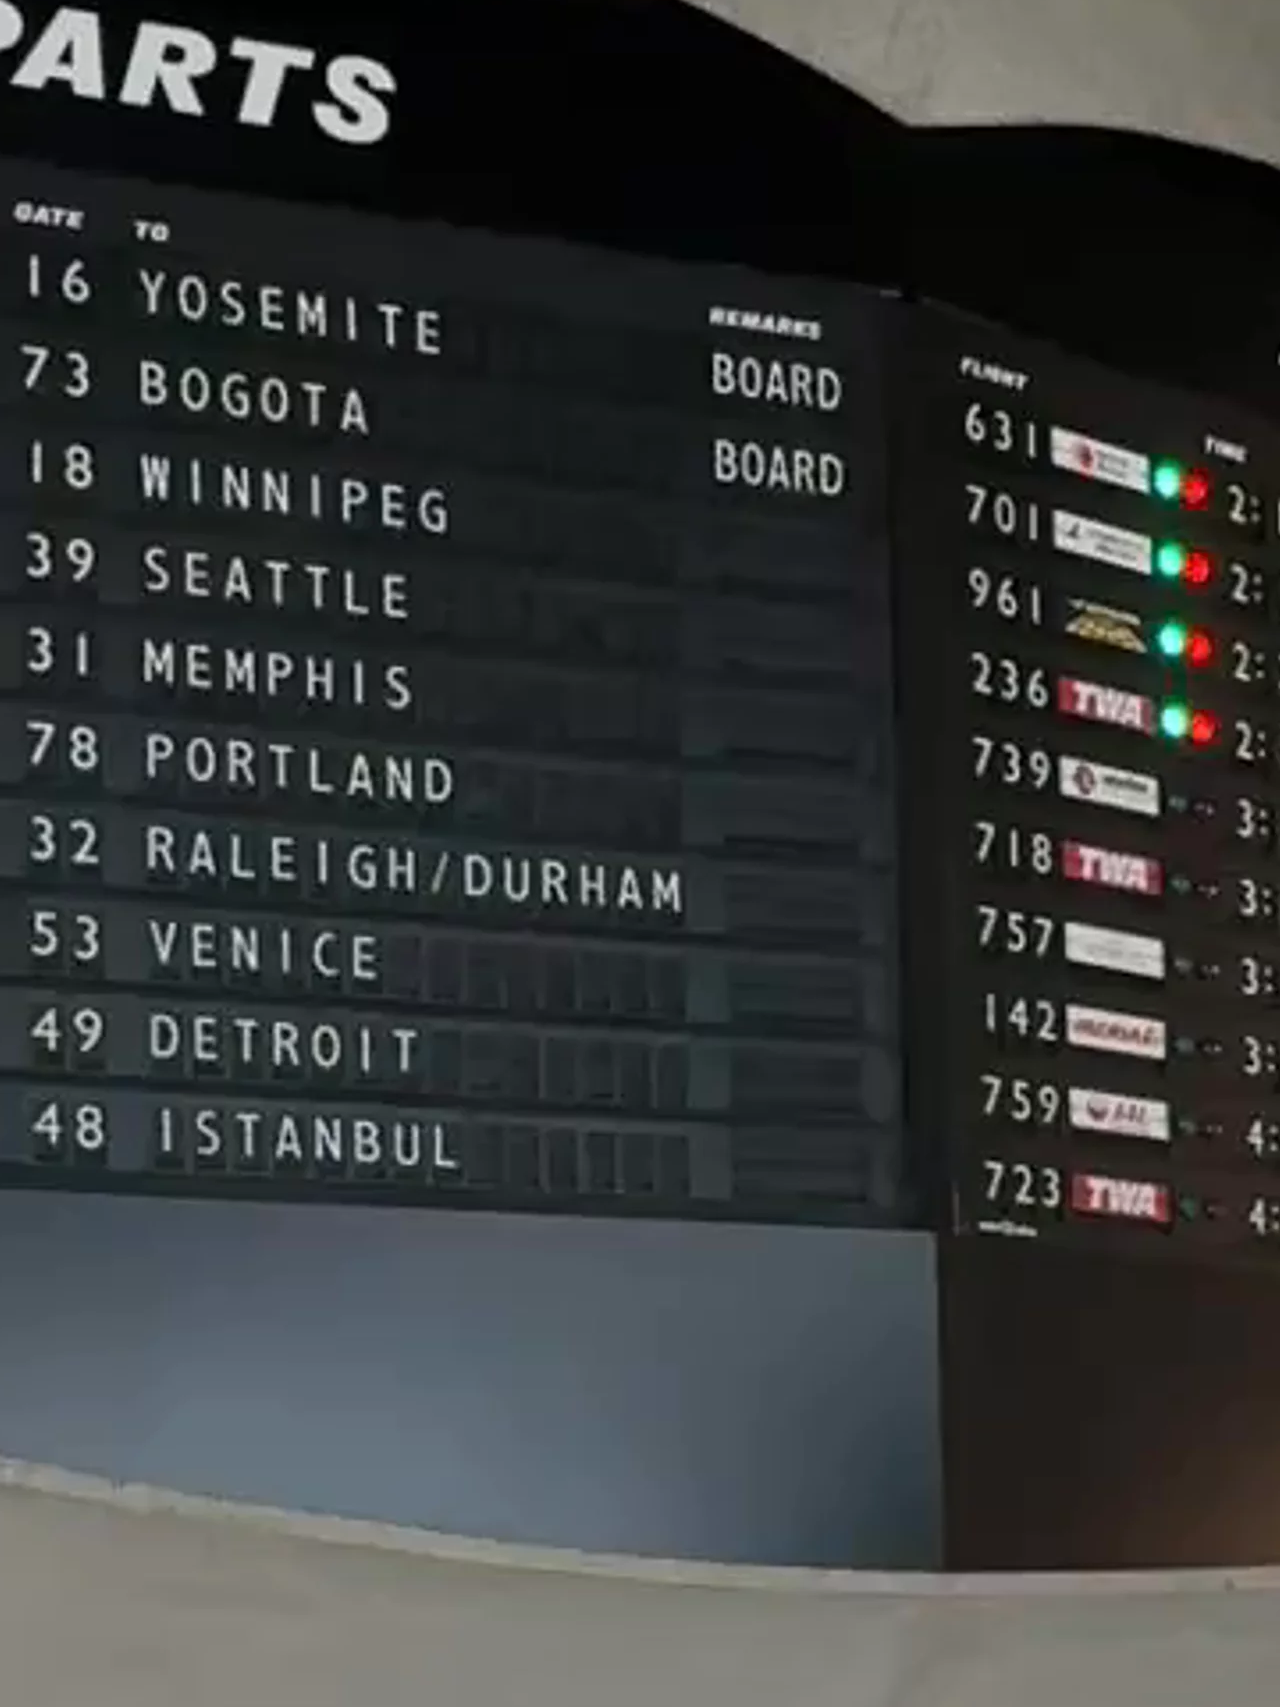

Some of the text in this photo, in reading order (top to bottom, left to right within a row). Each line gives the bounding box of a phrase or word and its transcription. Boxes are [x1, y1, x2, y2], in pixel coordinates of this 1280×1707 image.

[13, 202, 84, 229] GATE
[134, 220, 170, 242] TO
[29, 254, 90, 303] 16
[139, 269, 440, 355] YOSEMITE
[712, 352, 842, 410] BOARD
[21, 345, 90, 398] 73
[140, 360, 368, 434] BOGOTA
[714, 438, 843, 496] BOARD
[965, 403, 1036, 458] 631
[32, 441, 93, 490] 18
[140, 454, 447, 533] WINNIPEG
[965, 484, 1038, 541] 701
[26, 532, 94, 582] 39
[144, 546, 408, 618] SEATTLE
[968, 568, 1040, 624] 961
[28, 627, 88, 675] 31
[143, 639, 411, 710] MEMPHIS
[971, 651, 1048, 708] 236
[1073, 680, 1144, 727] TWA
[27, 721, 98, 771] 78
[146, 733, 452, 802] PORTLAND
[972, 736, 1051, 789] 739
[31, 815, 99, 864] 32
[146, 825, 681, 913] RALEIGH/DURHAM
[975, 821, 1053, 874] 718
[1078, 845, 1149, 891] TWA
[31, 911, 99, 960] 53
[149, 920, 377, 980] VENICE
[978, 905, 1054, 956] 757
[31, 1007, 103, 1052] 49
[150, 1013, 417, 1072] DETROIT
[986, 993, 1058, 1042] 142
[981, 1074, 1060, 1124] 759
[33, 1103, 104, 1150] 48
[161, 1108, 457, 1169] ISTANBUL
[984, 1160, 1060, 1208] 723
[1088, 1176, 1156, 1216] TWA
